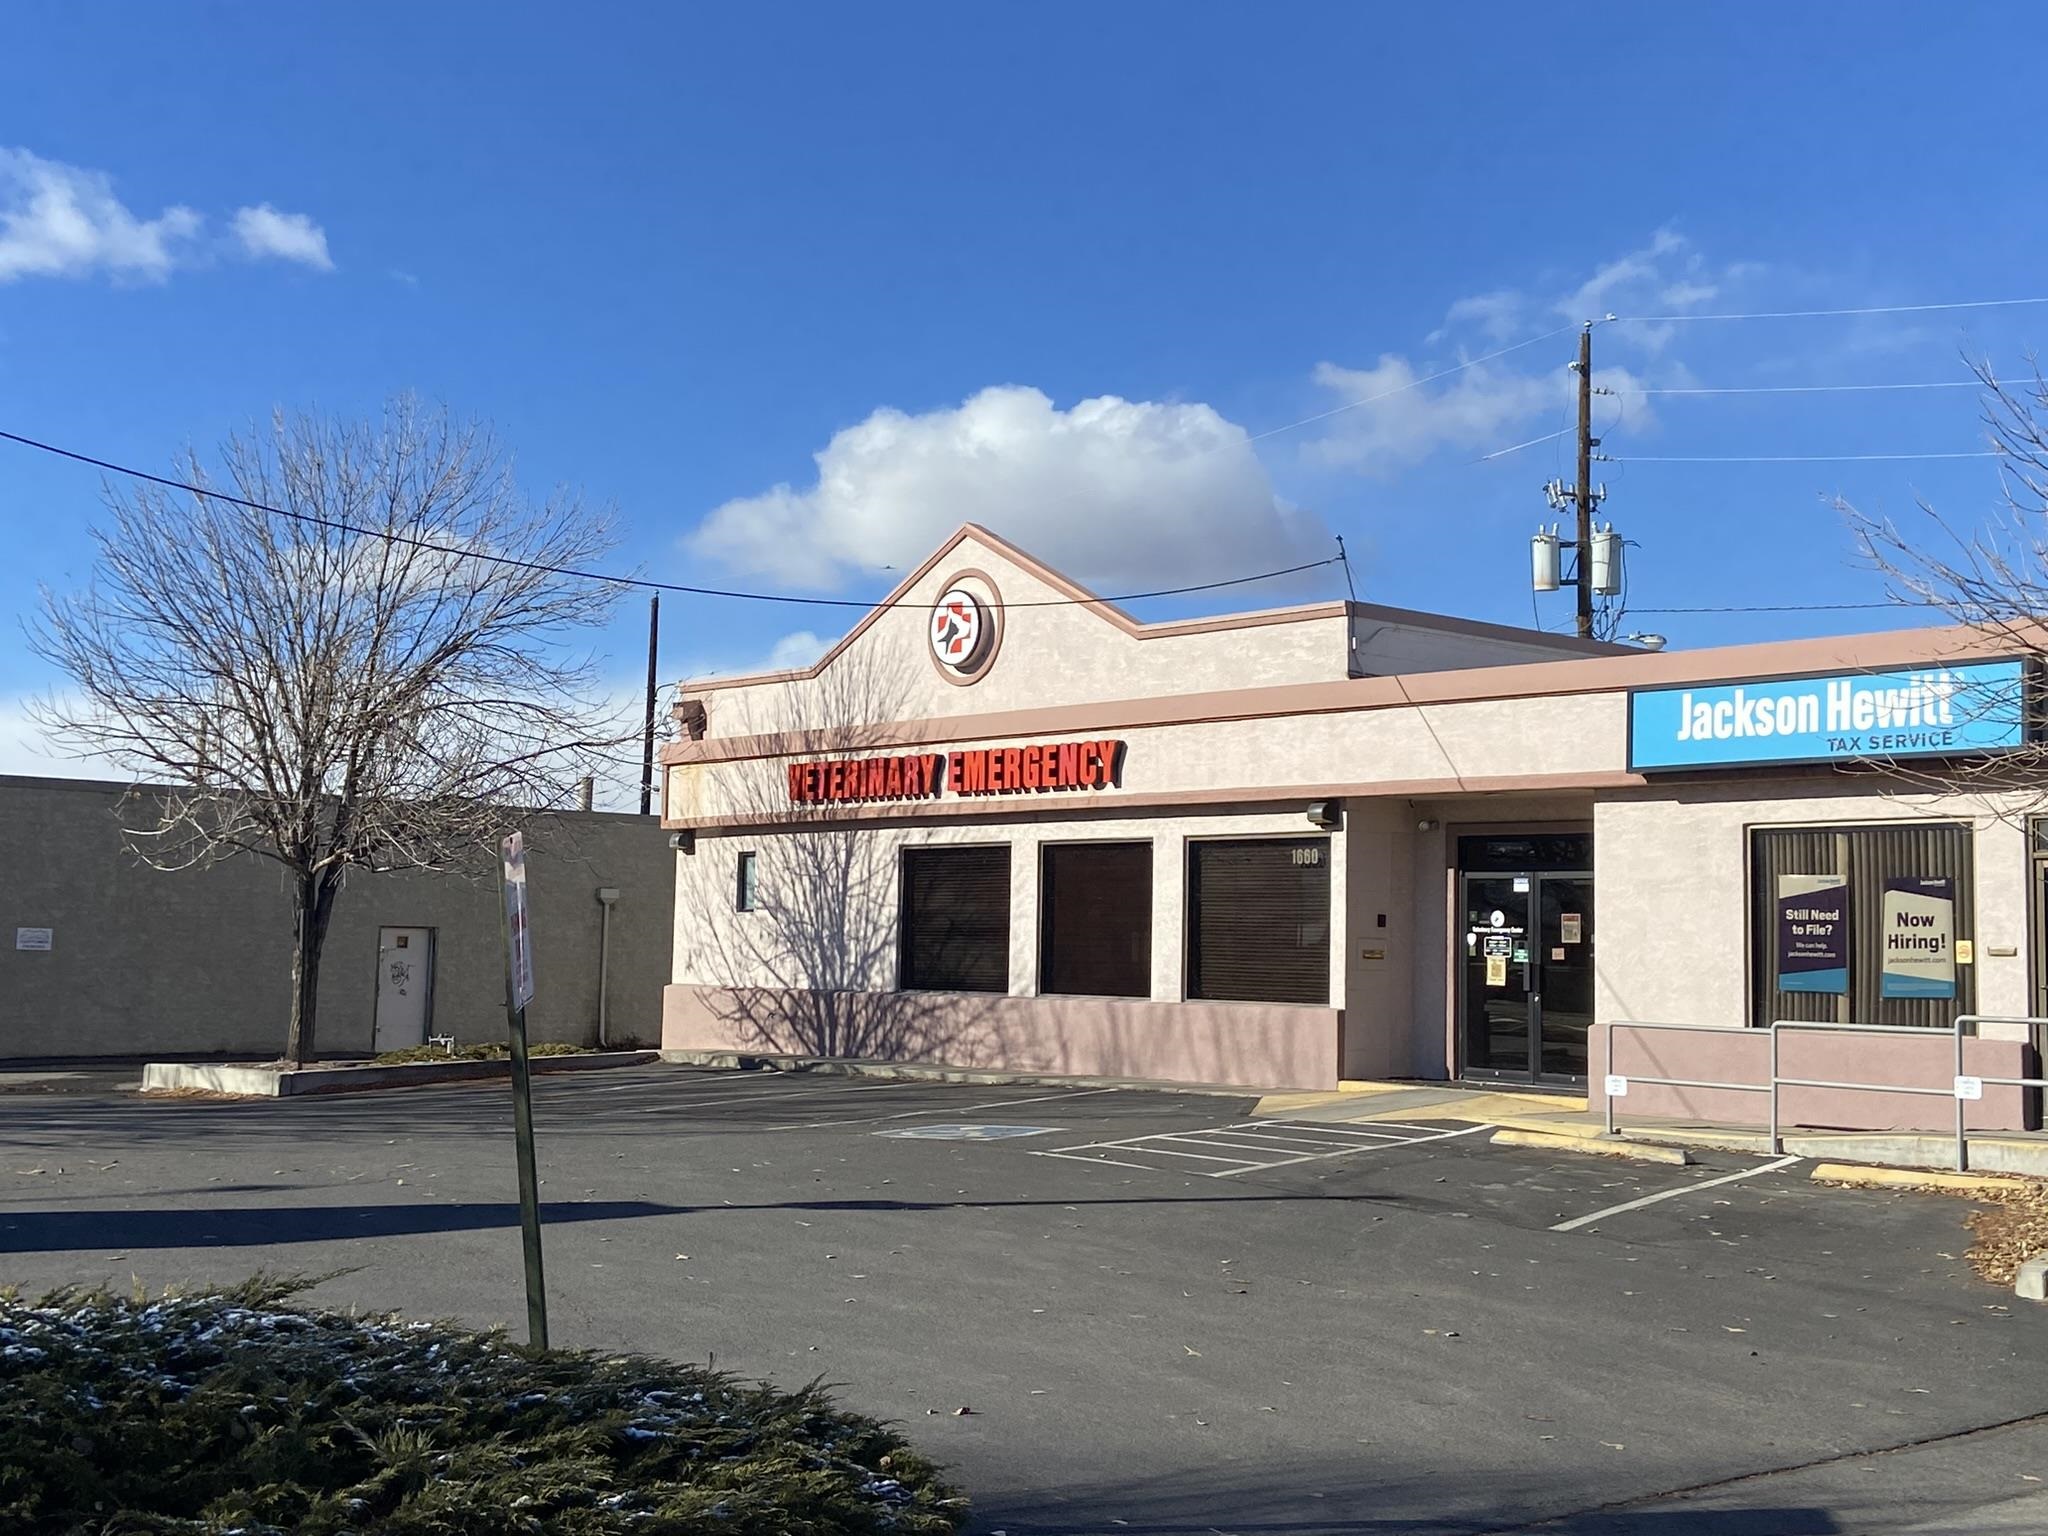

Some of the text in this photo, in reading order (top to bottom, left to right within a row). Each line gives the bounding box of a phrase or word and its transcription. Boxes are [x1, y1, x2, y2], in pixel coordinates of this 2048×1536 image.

[1677, 672, 1954, 741] Jackson Hewitt
[1827, 731, 1953, 752] TAX SERVICE
[789, 740, 1118, 801] VETERINARY EMERGENCY
[1291, 848, 1319, 865] 1660
[1785, 909, 1840, 921] Still Need
[1897, 912, 1935, 927] Now
[1792, 924, 1833, 936] to File?
[1888, 933, 1946, 953] Hiring!
